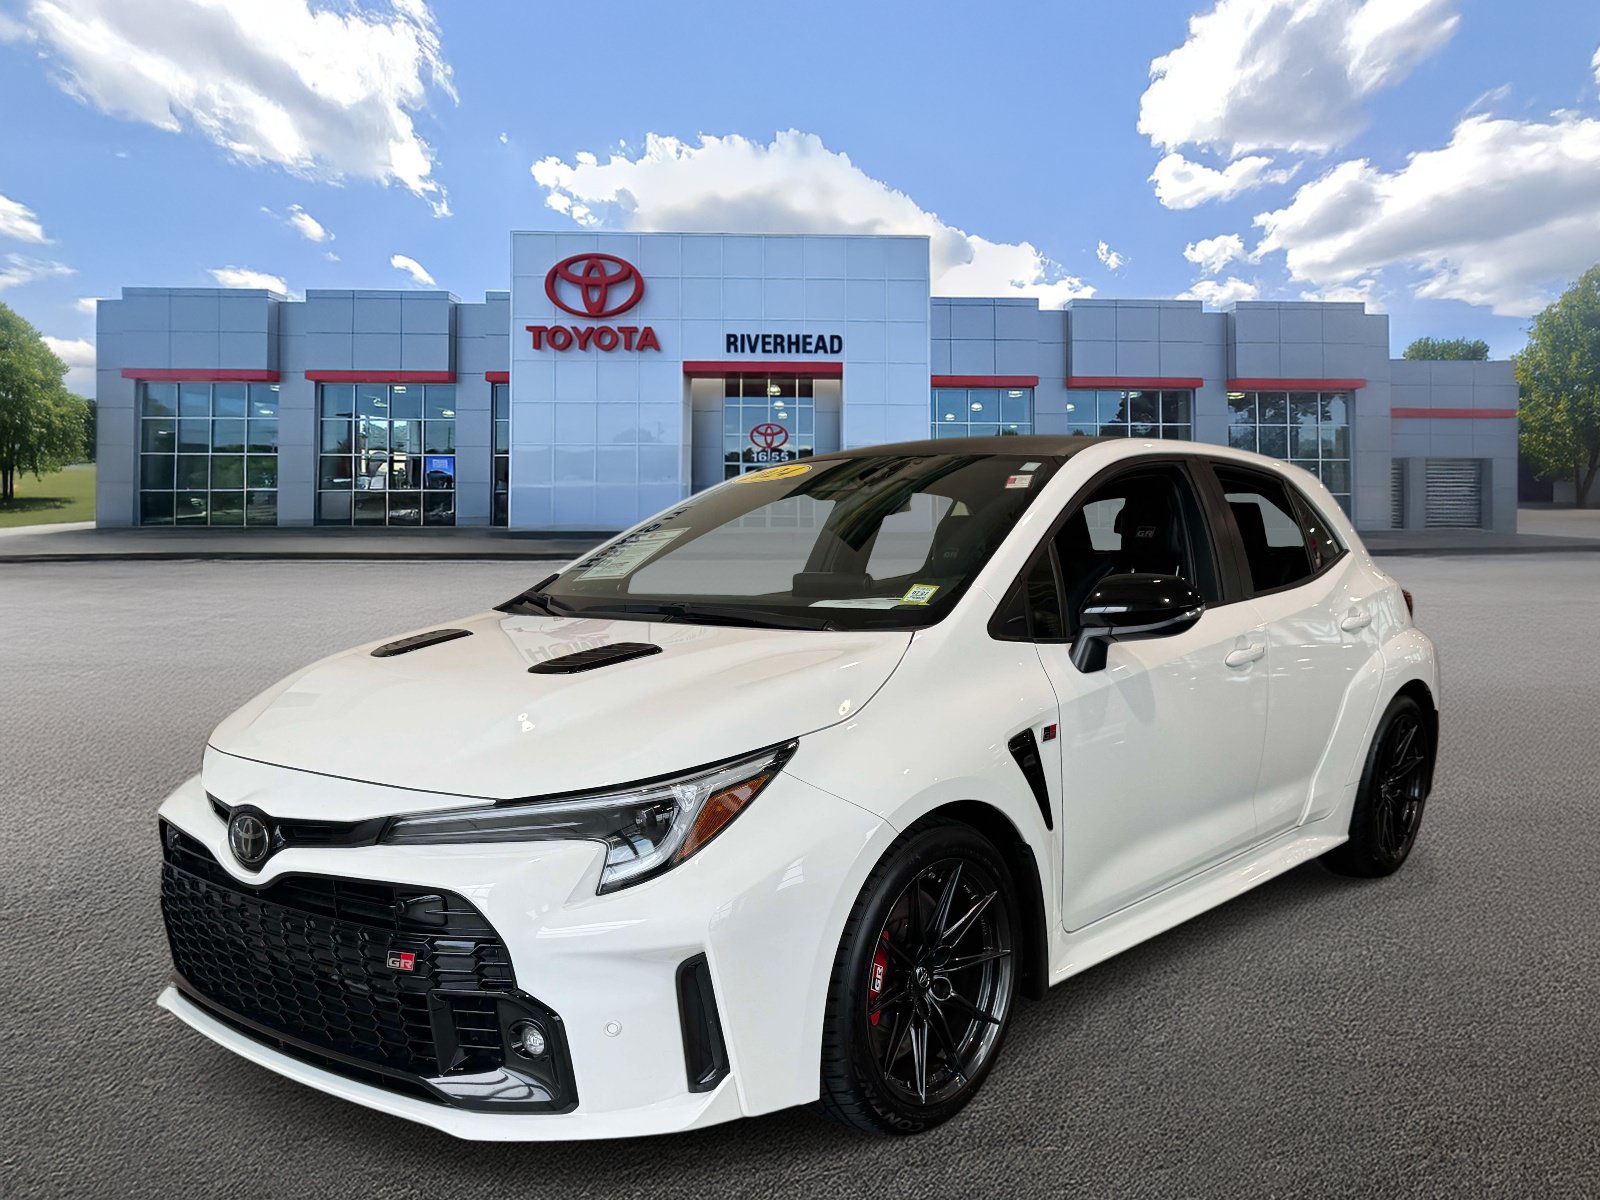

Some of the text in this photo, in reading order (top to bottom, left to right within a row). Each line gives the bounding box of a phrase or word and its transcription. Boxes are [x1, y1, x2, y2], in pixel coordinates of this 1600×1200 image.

[526, 325, 661, 352] TOYOTA
[725, 333, 843, 355] RIVERHEAD
[752, 451, 789, 462] 1655
[388, 957, 414, 969] GR
[874, 965, 883, 991] GR
